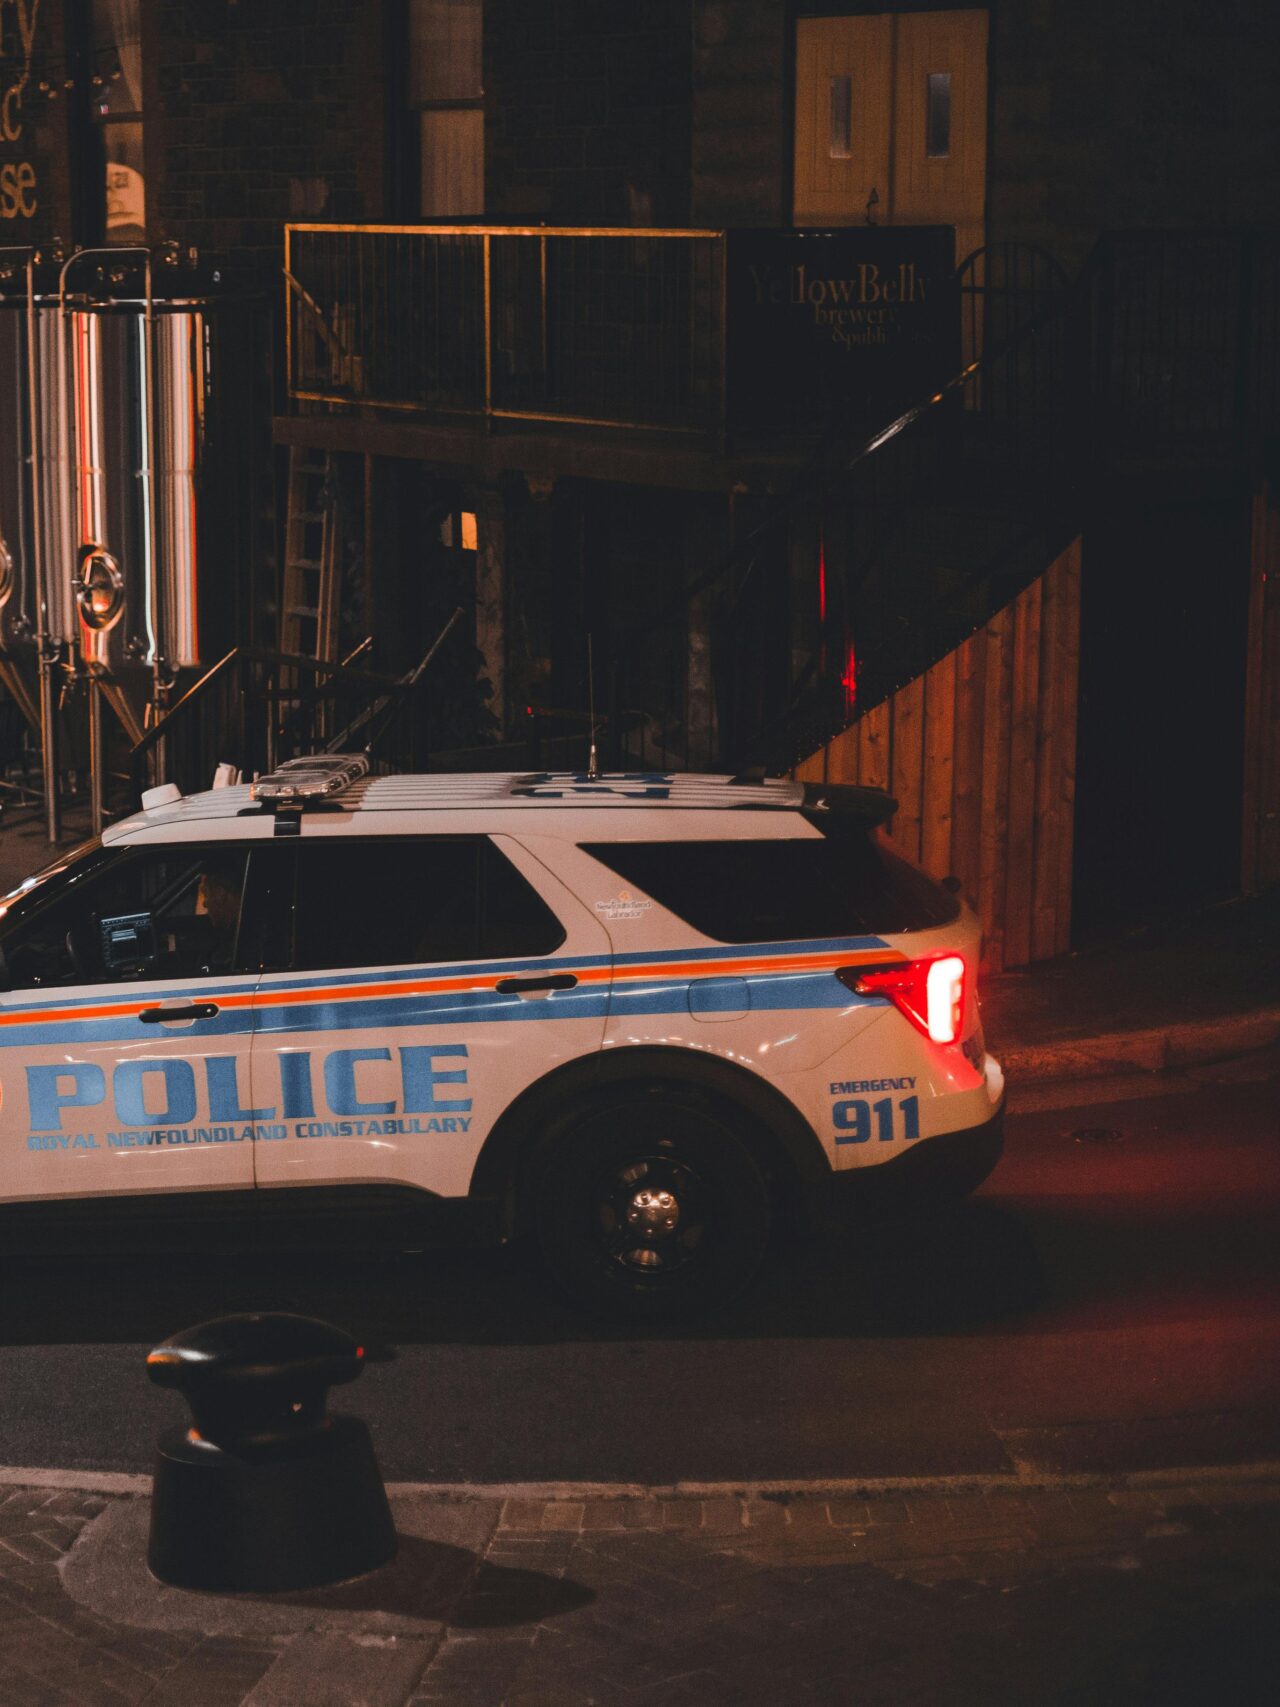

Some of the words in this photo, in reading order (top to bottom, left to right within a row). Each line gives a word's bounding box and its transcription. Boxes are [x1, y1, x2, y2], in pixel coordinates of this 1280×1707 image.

[25, 1044, 473, 1131] POLICE
[830, 1077, 917, 1095] EMERGENCY
[27, 1134, 101, 1151] ROYAL
[106, 1125, 287, 1147] NEWFOUNDLAND
[295, 1117, 472, 1138] CONSTABULARY
[832, 1096, 920, 1145] 911
